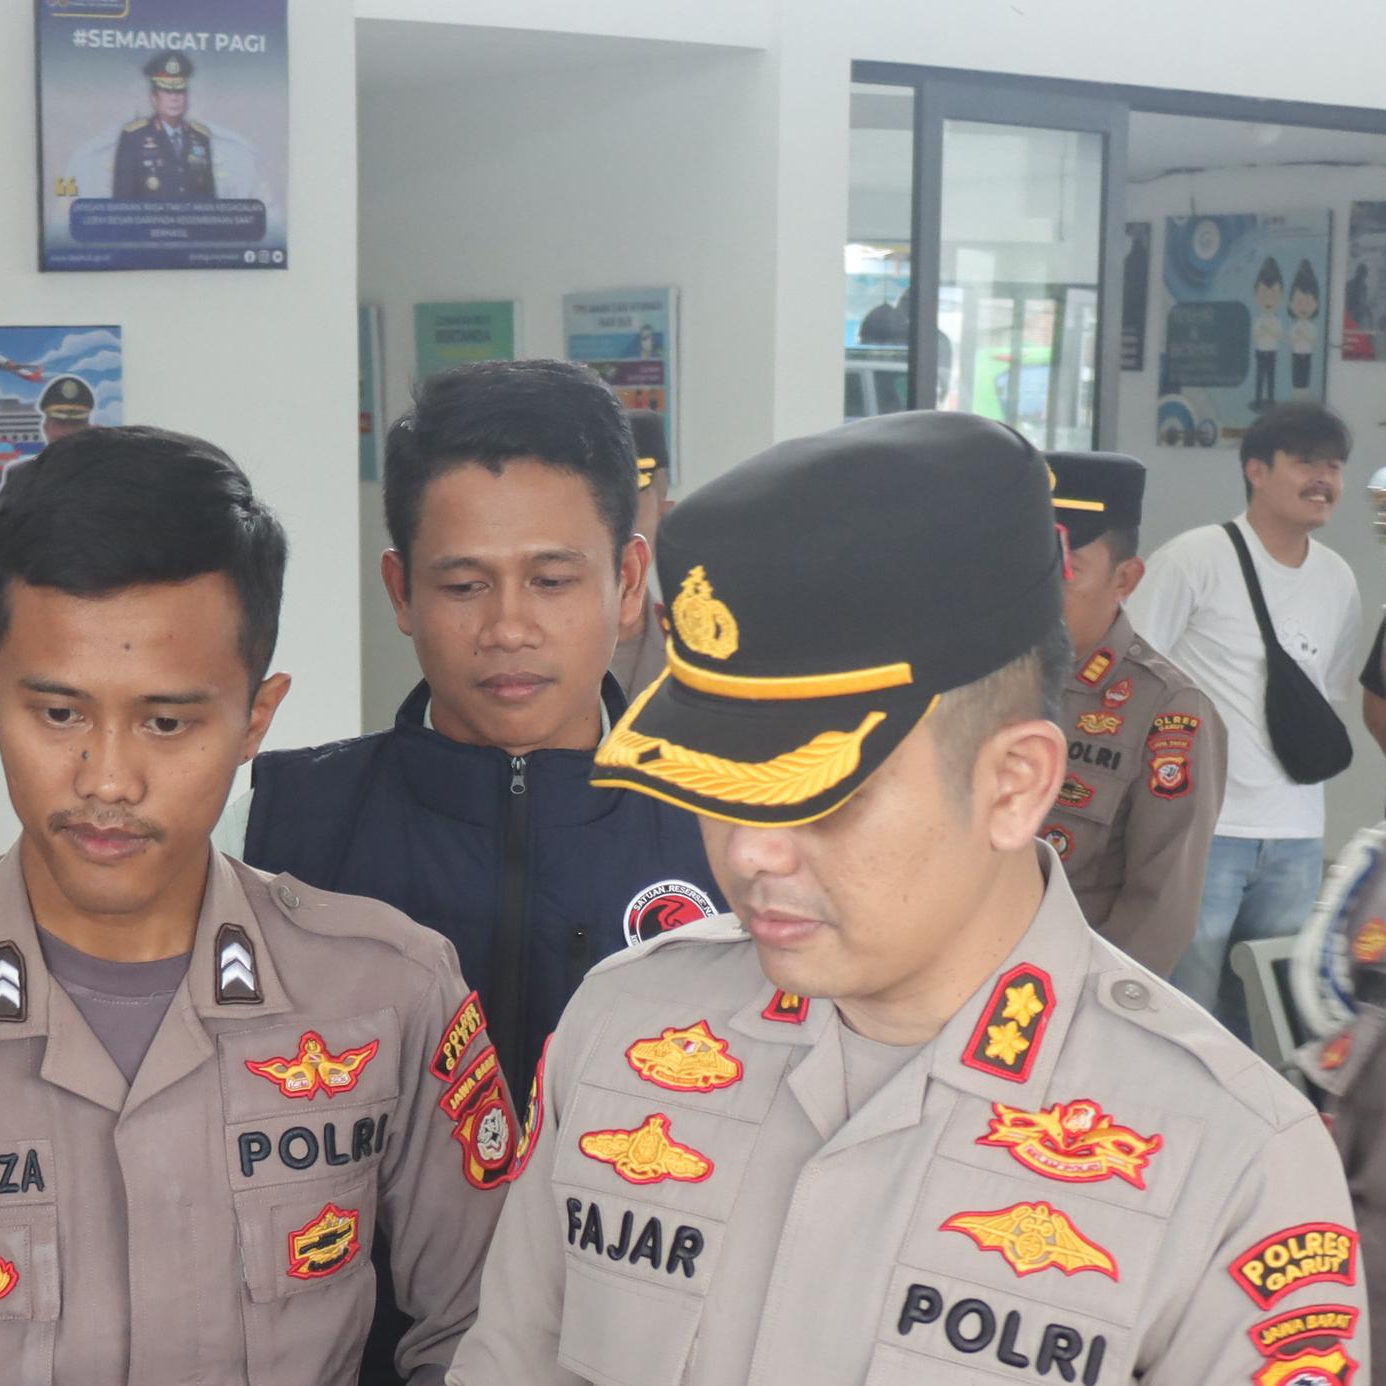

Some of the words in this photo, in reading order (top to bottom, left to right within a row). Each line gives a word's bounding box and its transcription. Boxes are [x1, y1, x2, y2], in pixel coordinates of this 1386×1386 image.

[73, 29, 209, 50] #SEMANGAT
[215, 33, 266, 52] PAGI
[1067, 741, 1122, 770] OLRI
[633, 884, 666, 912] SATUAN
[668, 884, 707, 910] RESERSE
[237, 1113, 390, 1178] POLRI
[565, 1197, 705, 1279] FAJAR
[1241, 1231, 1351, 1287] POLRES
[1265, 1255, 1344, 1291] GARUT
[1261, 1317, 1306, 1345] JAWA
[1305, 1312, 1354, 1331] BARAT
